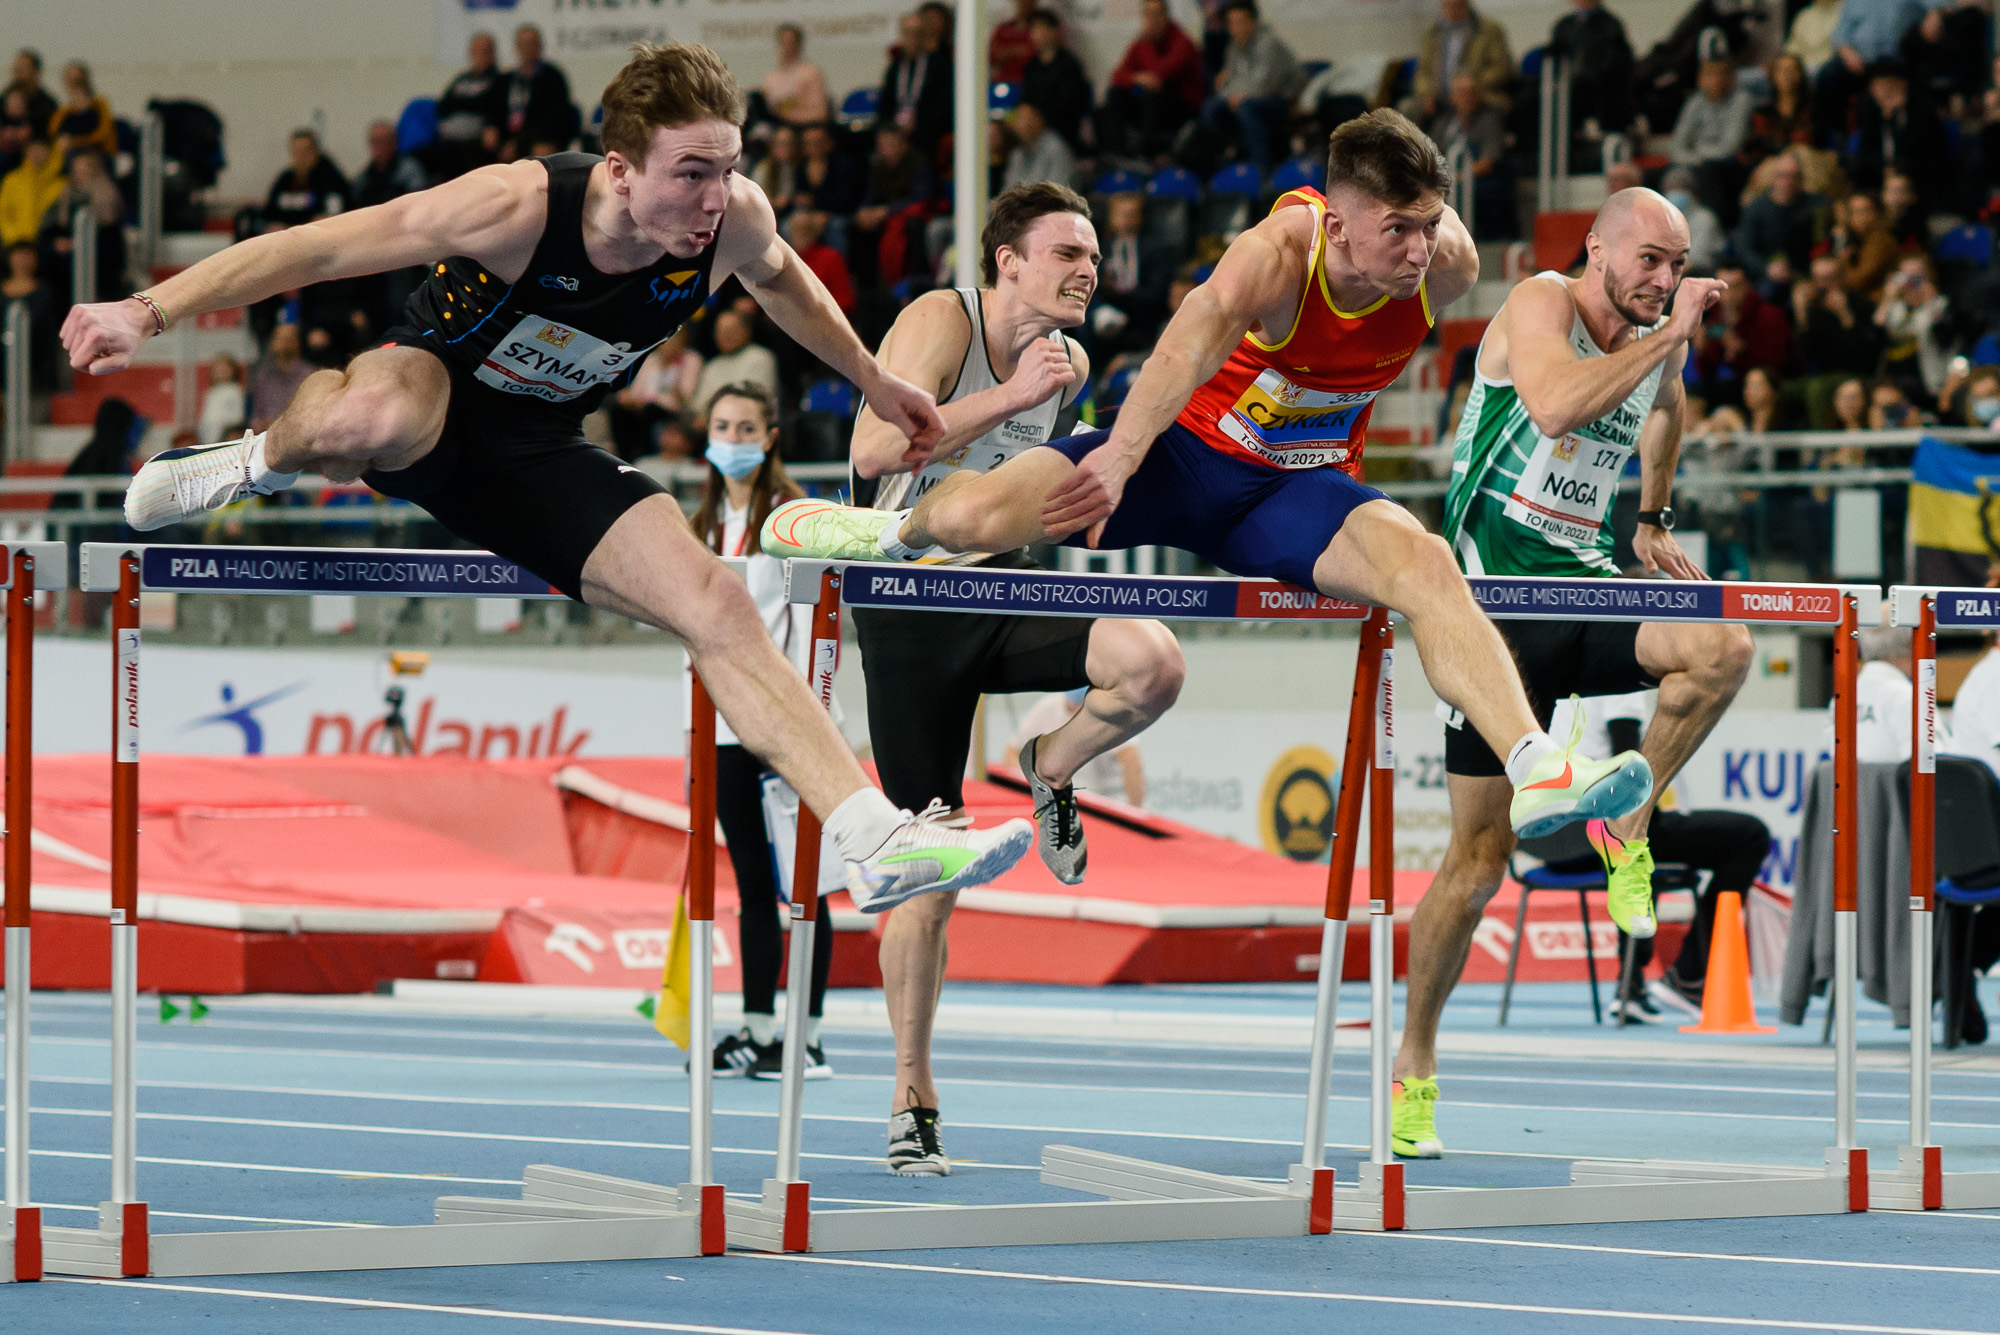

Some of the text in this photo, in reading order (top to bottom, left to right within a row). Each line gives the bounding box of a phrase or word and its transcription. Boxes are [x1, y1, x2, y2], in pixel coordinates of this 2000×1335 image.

[645, 273, 701, 310] Sopot
[501, 380, 558, 400] TORUŃ
[1329, 392, 1373, 404] 305
[1246, 402, 1351, 432] CZYKIER
[1612, 408, 1641, 429] AWF
[1240, 433, 1326, 466] TORUŃ 2022
[1592, 450, 1622, 470] 171
[1542, 472, 1598, 508] NOGA
[1525, 512, 1564, 534] TORUŃ
[1564, 526, 1588, 540] 2022
[171, 558, 518, 584] PZLA HALOWE MISTRZOSTWA POLSKI
[870, 576, 918, 596] PZLA
[923, 578, 1005, 600] HALOWE
[1010, 583, 1140, 606] MISTRZOSTWA
[1145, 588, 1208, 608] POLSKI
[1474, 586, 1832, 613] ALOWE MISTRZOSTWA POLSKI TORUŃ 2022
[1956, 600, 1992, 616] PZLA
[124, 660, 139, 728] polanik
[1382, 678, 1394, 738] polanik
[304, 696, 593, 758] polanik
[1924, 687, 1936, 744] polanik
[1725, 751, 1831, 814] KUJ
